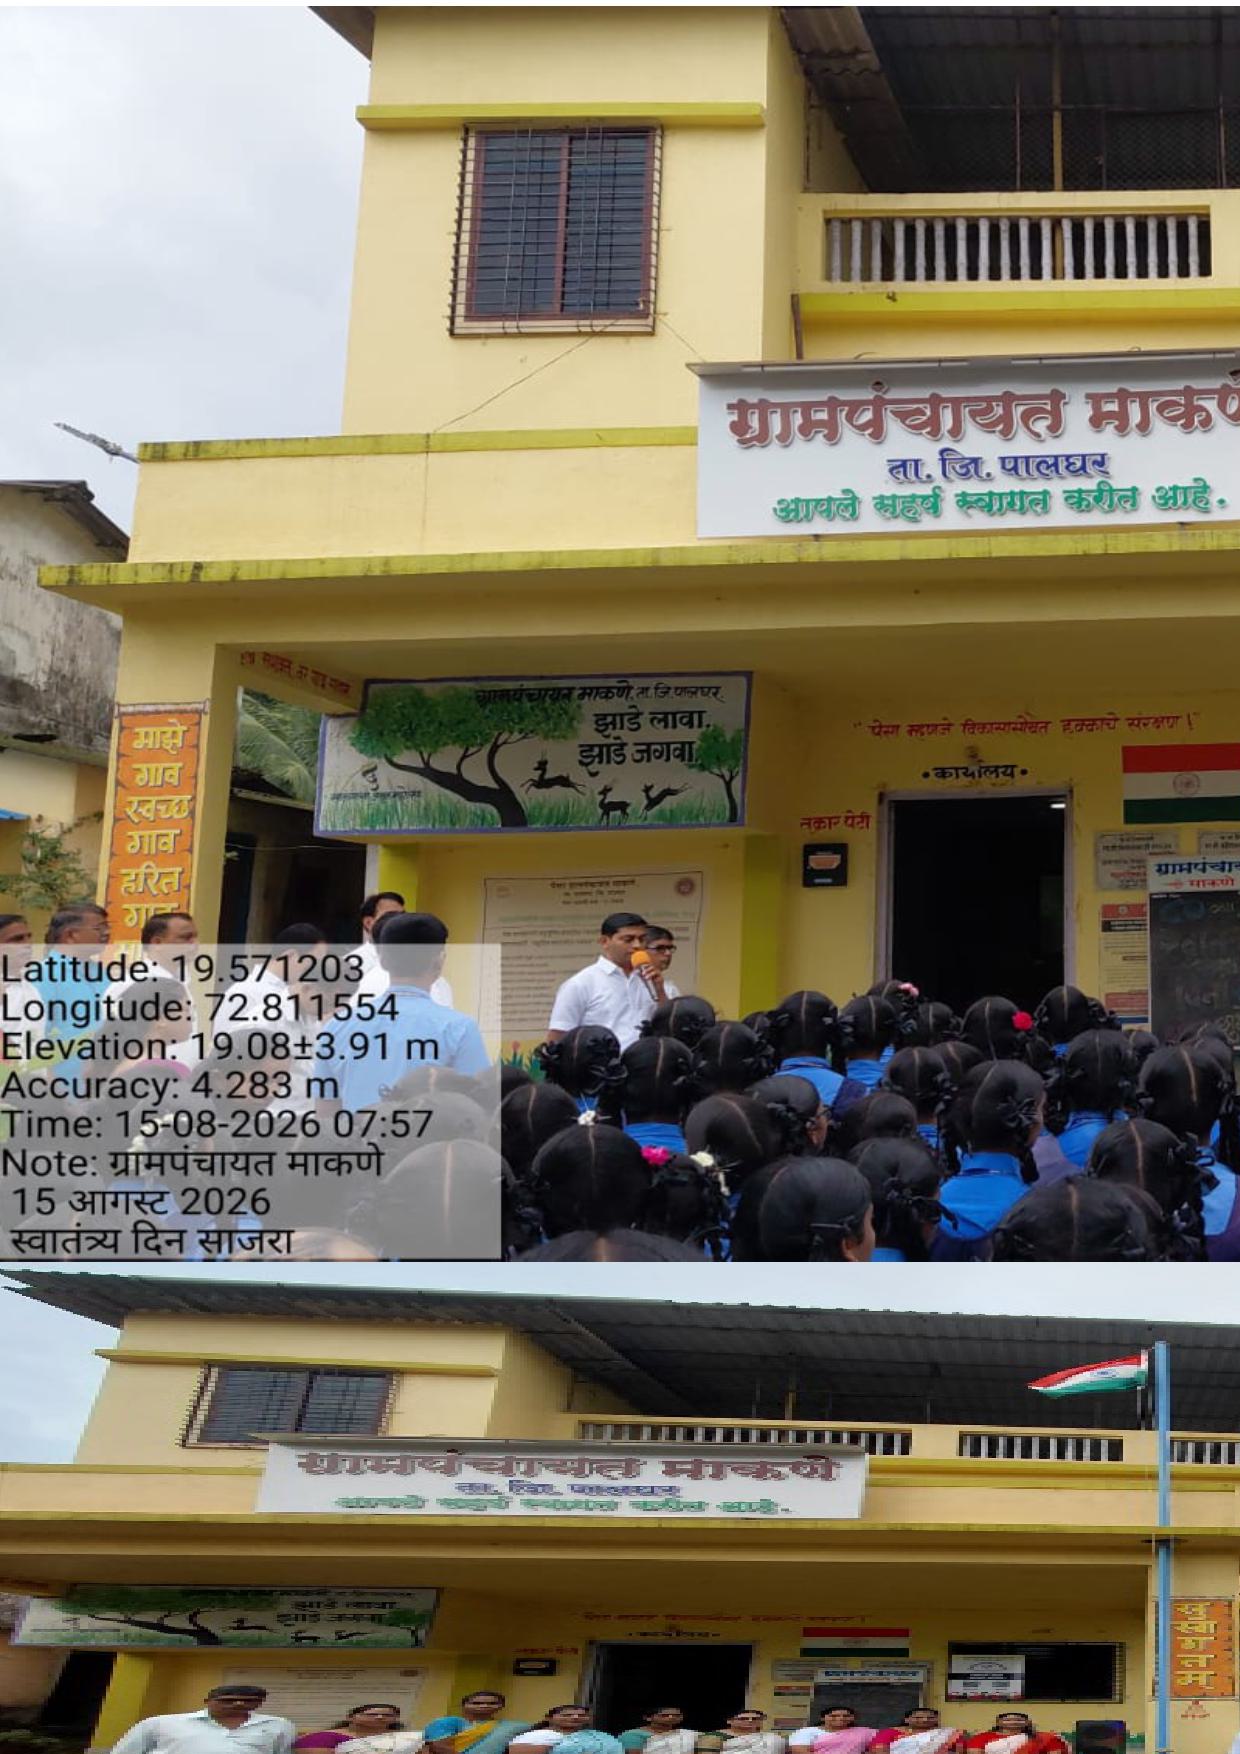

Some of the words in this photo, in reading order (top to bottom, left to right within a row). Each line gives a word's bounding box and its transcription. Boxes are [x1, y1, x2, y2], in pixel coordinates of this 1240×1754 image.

[727, 380, 1068, 448] ग्रामपंचायत
[999, 449, 1111, 479] पालघर
[772, 488, 861, 523] आपले
[874, 486, 943, 522] सहर्ष
[954, 485, 1051, 517] स्वागत
[1063, 479, 1139, 514] करीत
[132, 719, 187, 754] माझे
[593, 705, 644, 738] झाडे
[577, 736, 629, 776] झाडे
[131, 762, 184, 788] गाव
[124, 795, 192, 824] स्वच्छ
[127, 828, 181, 855] गाव
[120, 861, 182, 897] हरित
